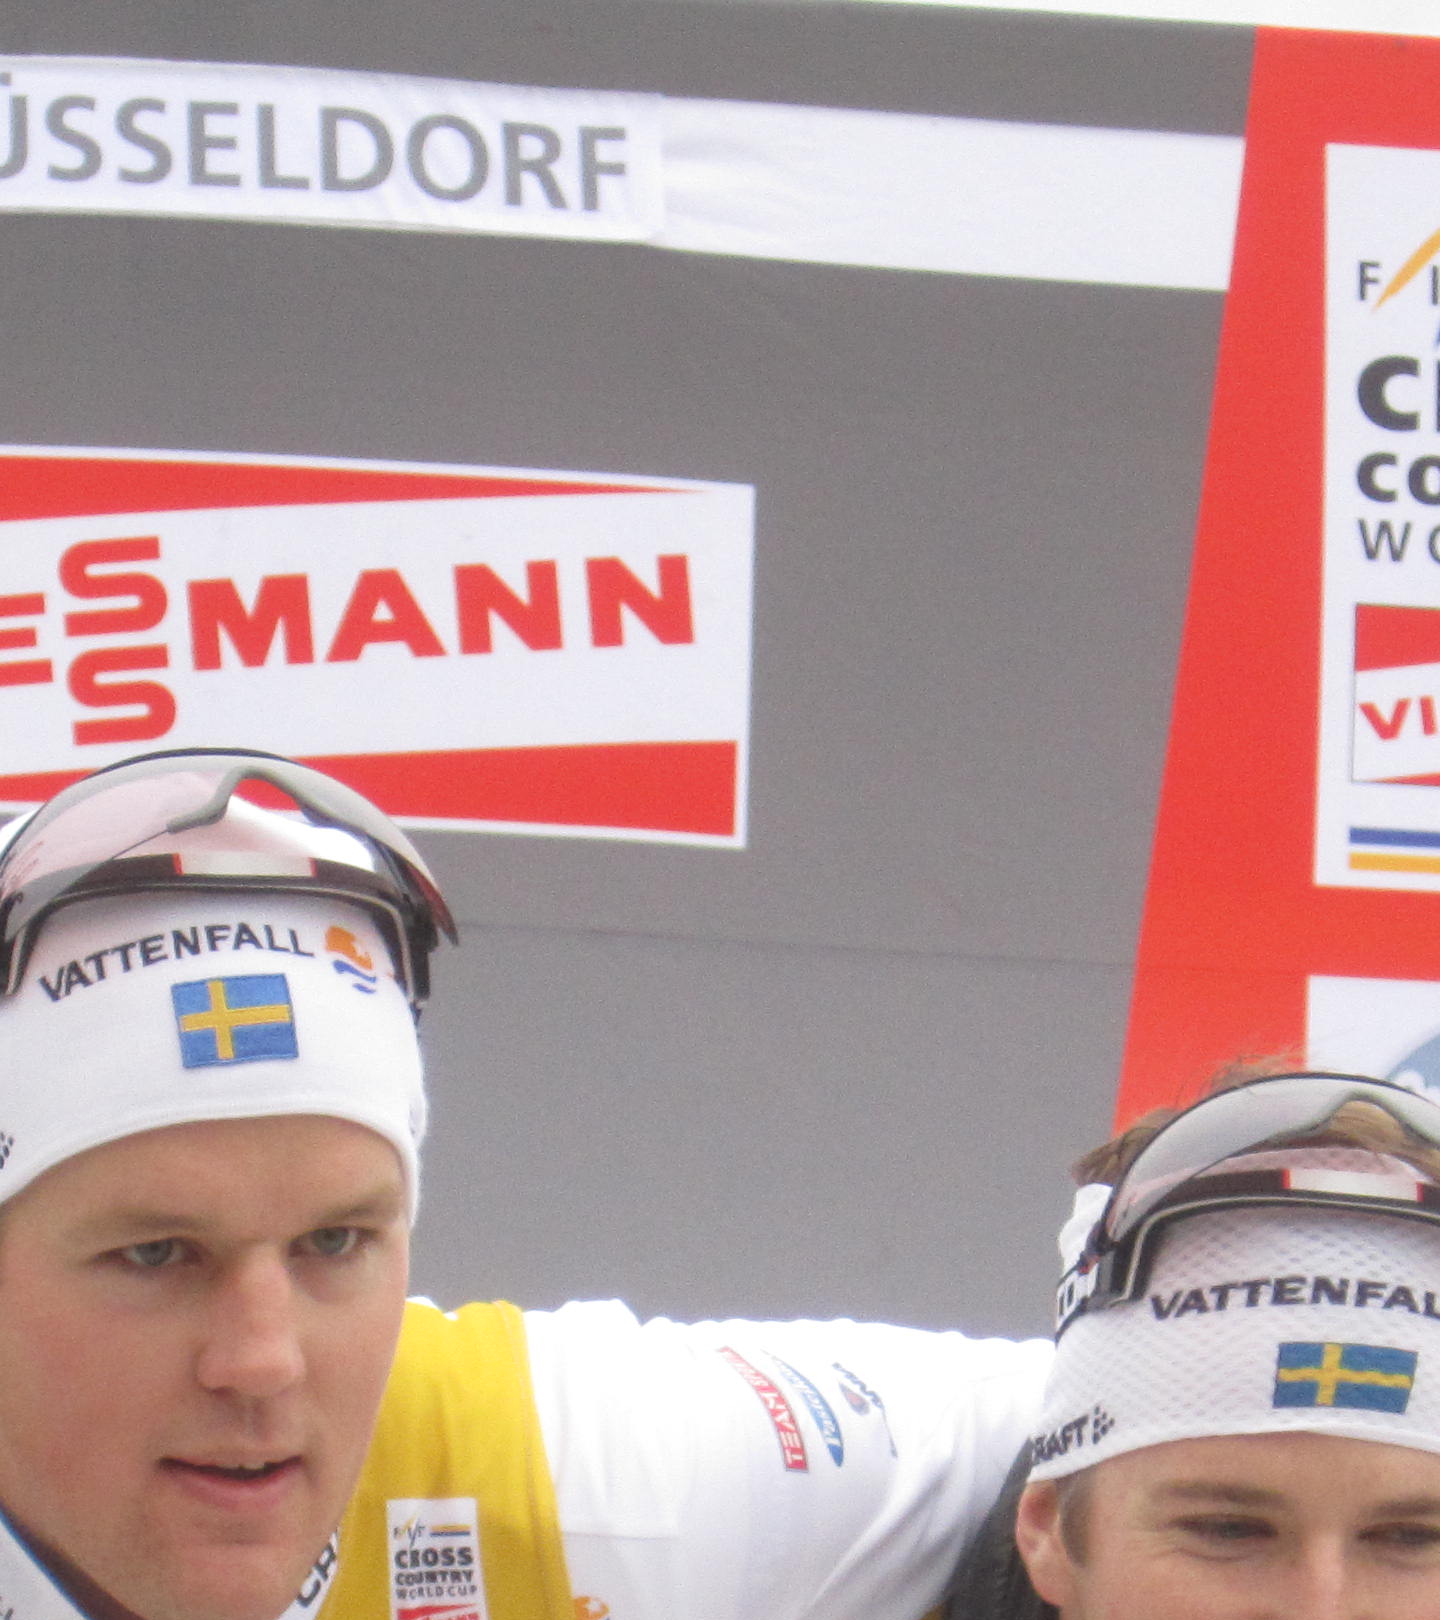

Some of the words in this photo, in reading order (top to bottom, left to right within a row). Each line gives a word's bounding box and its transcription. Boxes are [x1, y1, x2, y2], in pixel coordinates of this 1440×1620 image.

[40, 923, 316, 1002] VATTENFALL
[394, 1546, 474, 1569] CROSS
[395, 1569, 475, 1586] COUNTRY
[396, 1585, 445, 1600] WORLD
[448, 1584, 478, 1598] CUP
